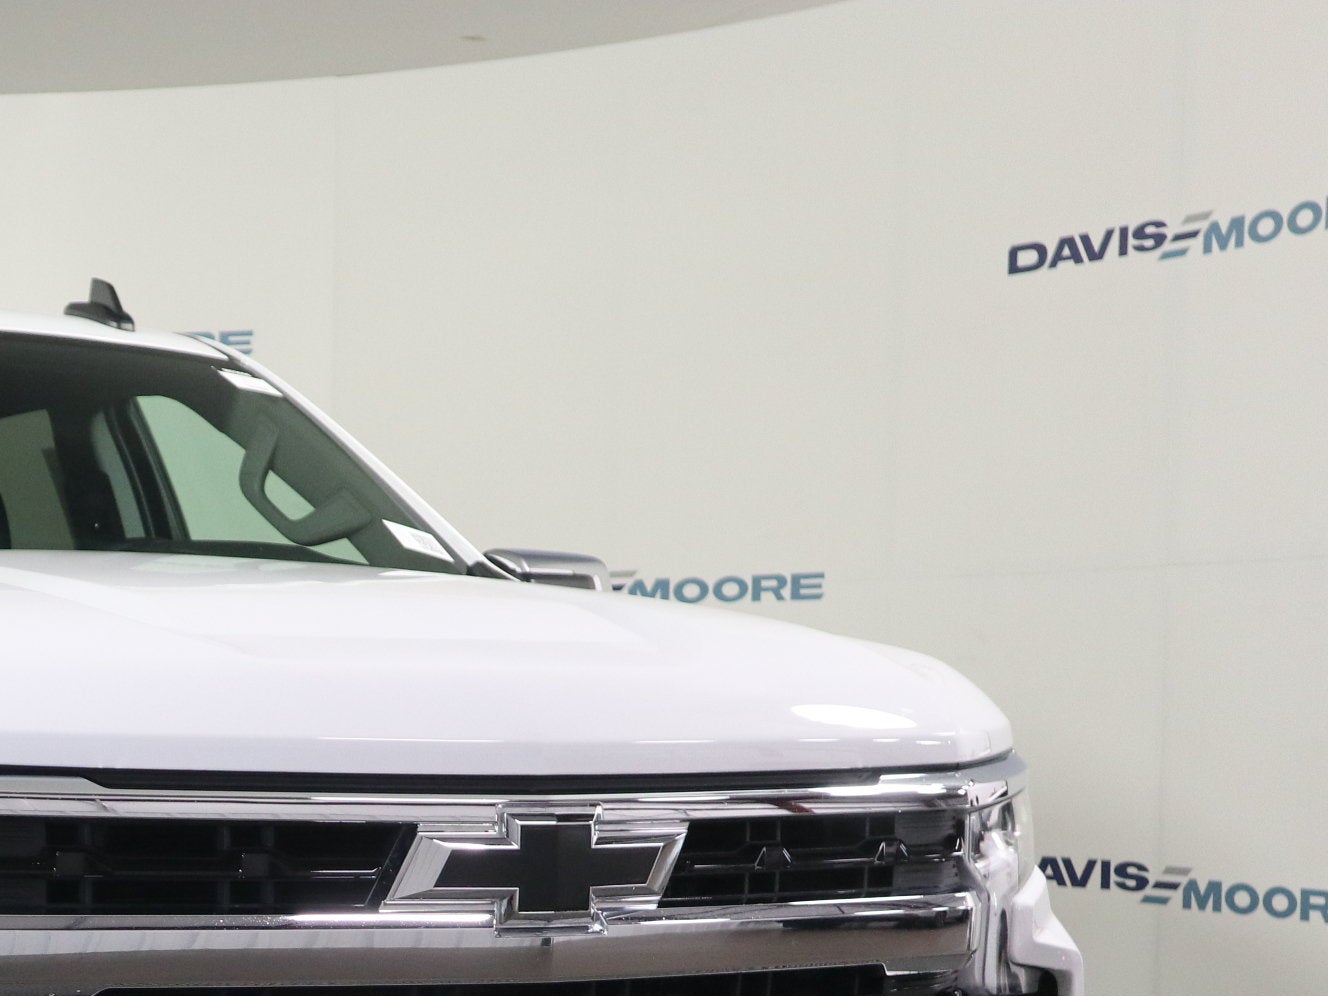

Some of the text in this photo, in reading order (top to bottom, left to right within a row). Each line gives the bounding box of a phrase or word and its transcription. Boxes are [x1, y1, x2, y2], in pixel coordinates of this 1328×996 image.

[1007, 196, 1328, 275] DAVIS MOO
[627, 572, 826, 604] MOORE
[1038, 856, 1328, 924] AVIS MOOR
